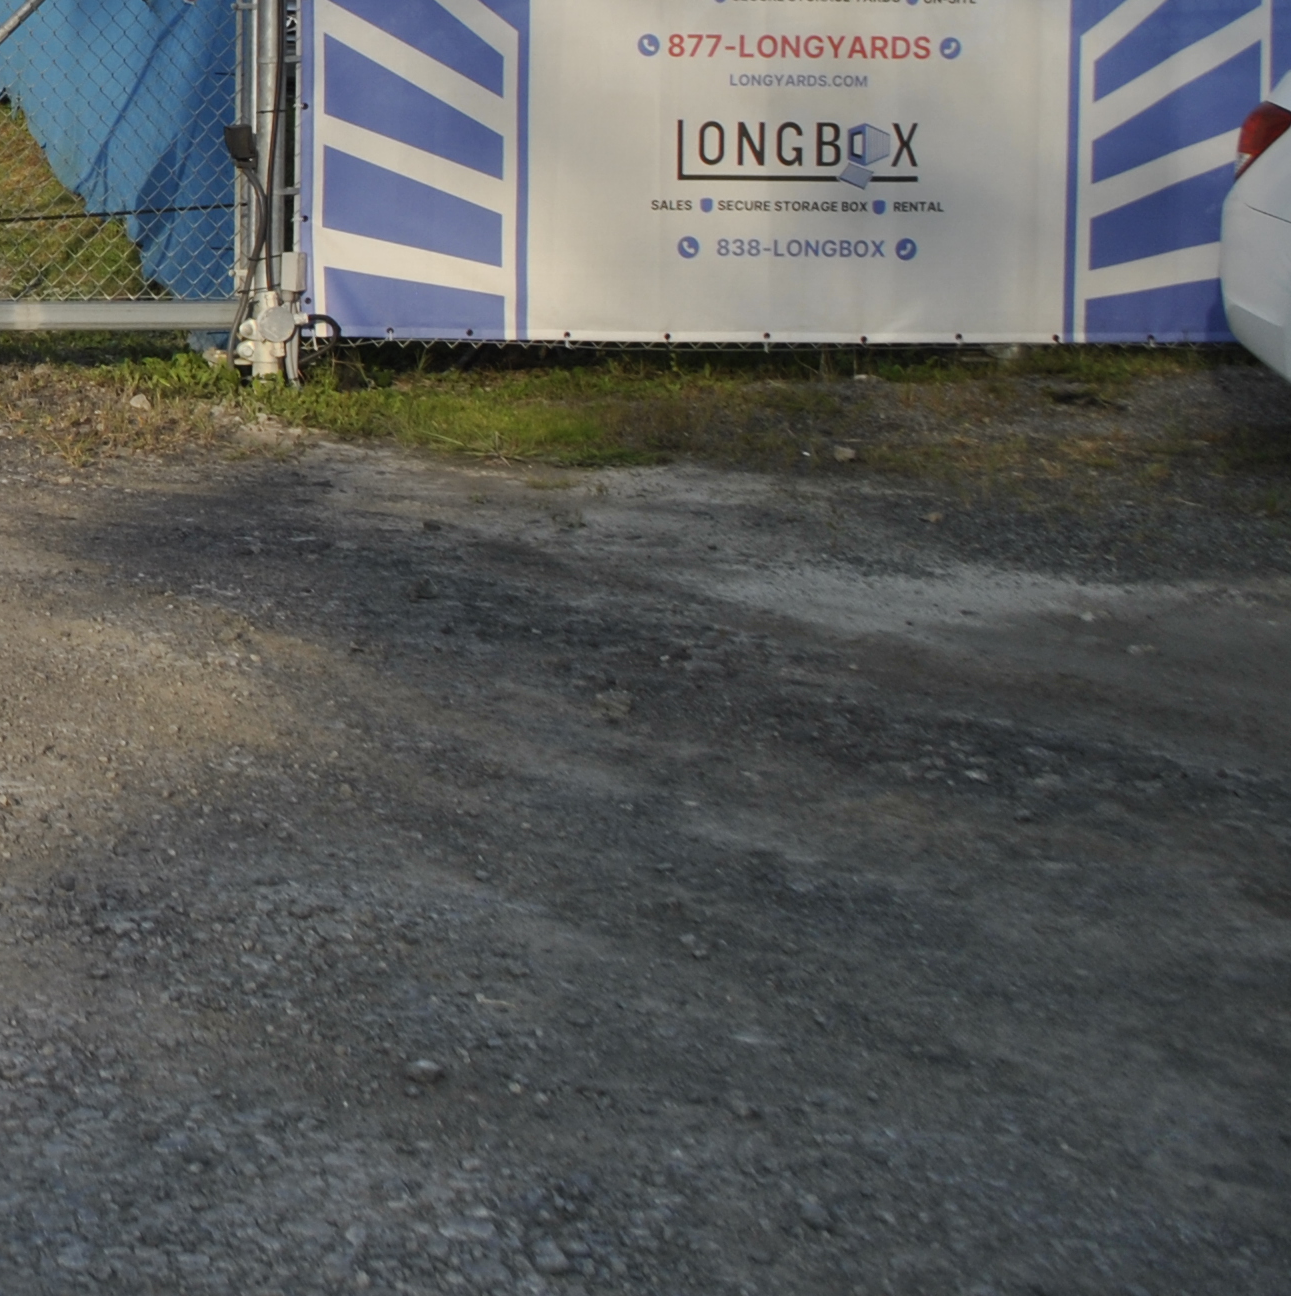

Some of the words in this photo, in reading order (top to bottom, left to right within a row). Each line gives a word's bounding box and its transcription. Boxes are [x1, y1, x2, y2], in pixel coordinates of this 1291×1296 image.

[668, 33, 932, 61] 877-LONGYARDS
[729, 74, 868, 88] LONGYARDS.COM
[677, 119, 918, 183] LONGBOX
[651, 200, 693, 211] SALES
[717, 200, 770, 212] SECURE
[774, 201, 838, 212] STORAGE
[841, 201, 868, 212] BOX
[893, 202, 944, 213] RENTAL
[716, 238, 886, 258] 838-LONGBOX
